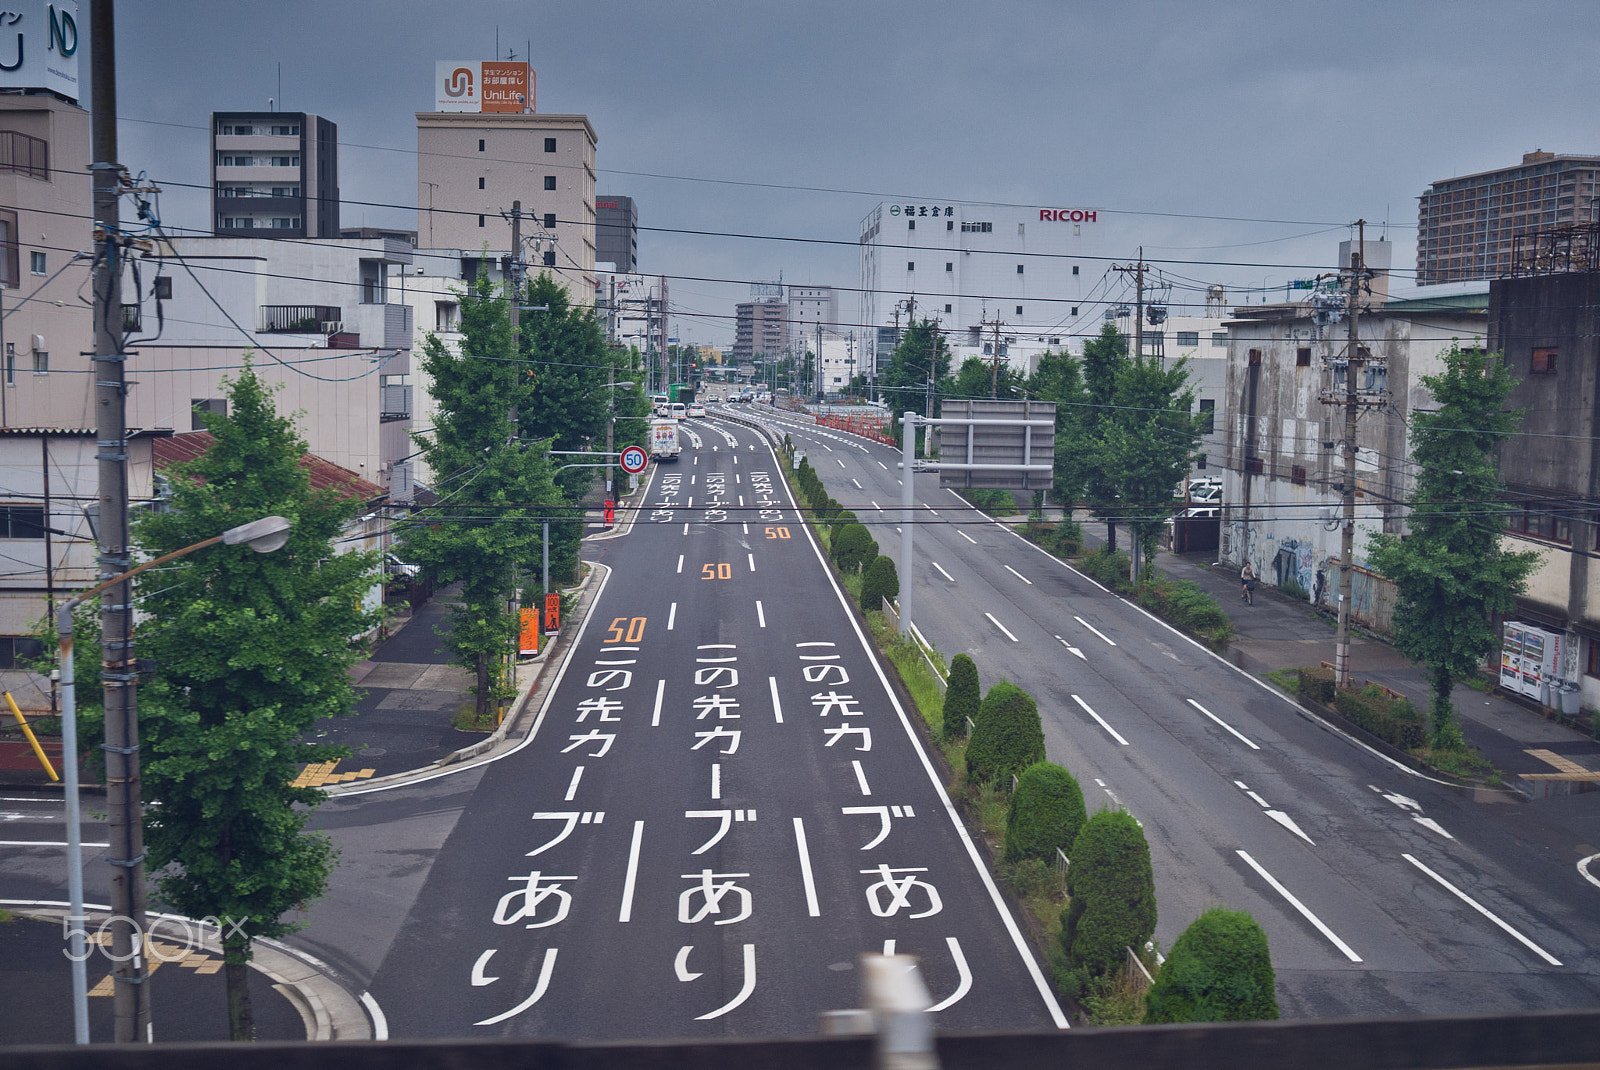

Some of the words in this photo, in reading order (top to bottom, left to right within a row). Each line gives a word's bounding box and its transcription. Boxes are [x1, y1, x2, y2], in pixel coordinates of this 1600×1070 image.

[483, 77, 524, 85] お部屋探し
[483, 90, 522, 100] UniLife
[595, 200, 618, 209] innai
[904, 205, 954, 218] 福玉倉庫
[1039, 209, 1097, 222] RICOH
[626, 453, 642, 466] 50
[764, 526, 791, 540] 50
[701, 563, 732, 580] 50
[547, 598, 558, 606] 100
[603, 616, 647, 643] 50
[674, 644, 757, 1022] この先カーブあり
[795, 641, 973, 1013] この先カーブあり
[470, 645, 641, 1027] この先カーブあり
